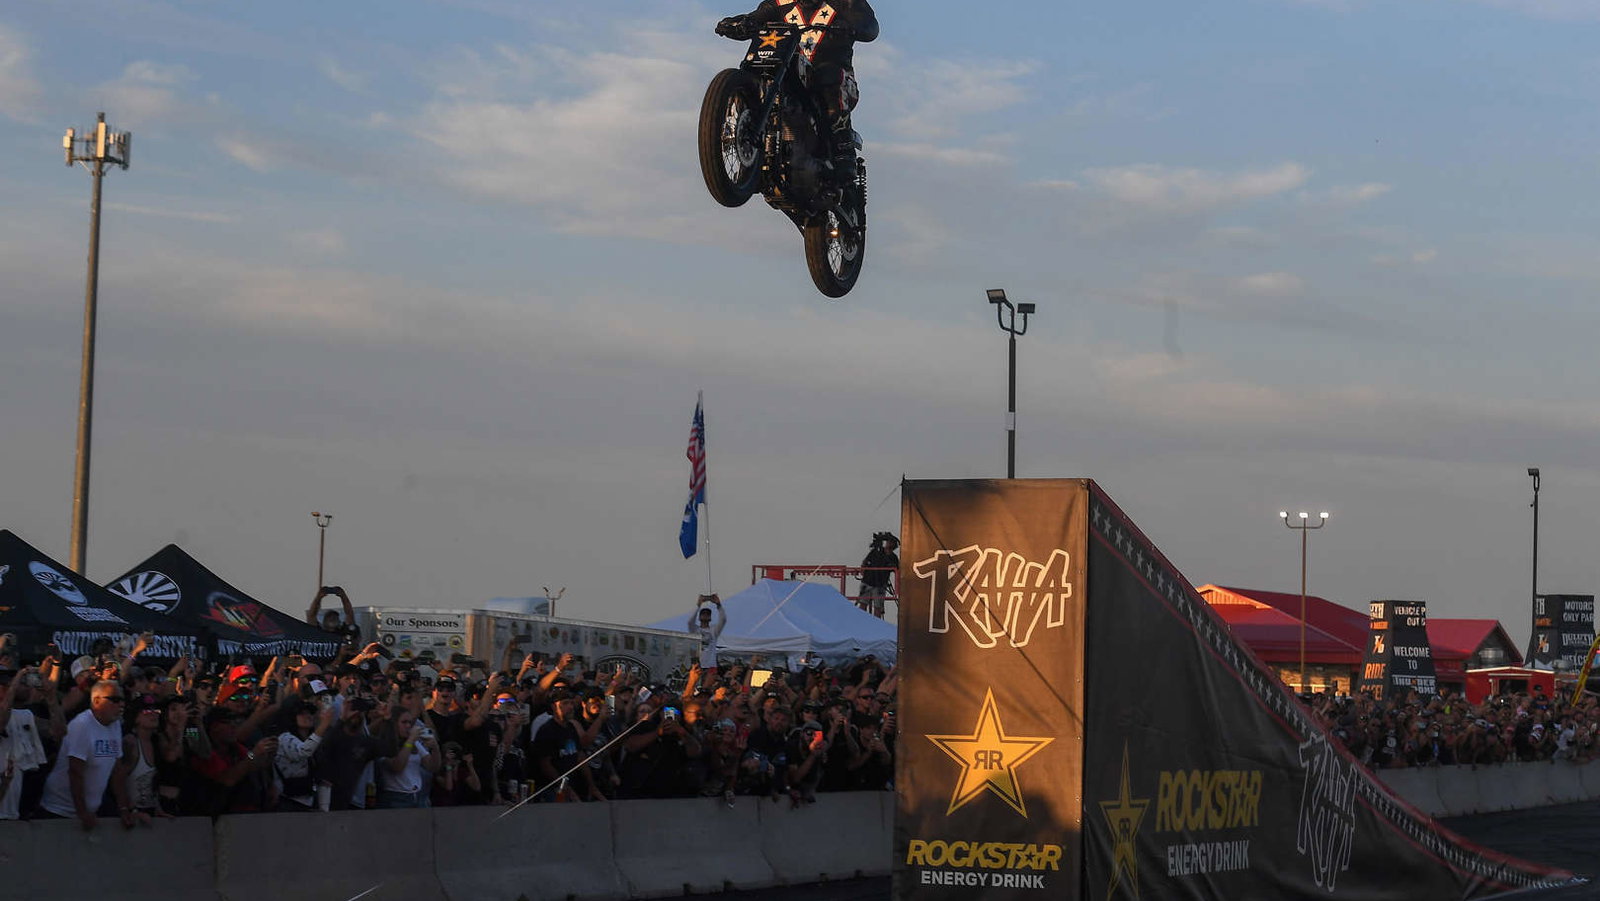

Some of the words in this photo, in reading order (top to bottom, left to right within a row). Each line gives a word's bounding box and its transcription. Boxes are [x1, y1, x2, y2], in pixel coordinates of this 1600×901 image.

[386, 617, 406, 626] Our
[408, 617, 459, 629] Sponsors
[1406, 617, 1420, 626] OUT
[1393, 646, 1430, 658] WELCOME
[1364, 663, 1386, 679] RIDE
[1407, 660, 1418, 670] TO
[1155, 769, 1263, 833] ROCKSTAR
[906, 839, 1062, 871] ROCKSTAR
[1167, 842, 1215, 877] ENERGY
[1215, 840, 1250, 873] DRINK
[920, 870, 988, 888] ENERGY
[991, 872, 1045, 889] DRINK
